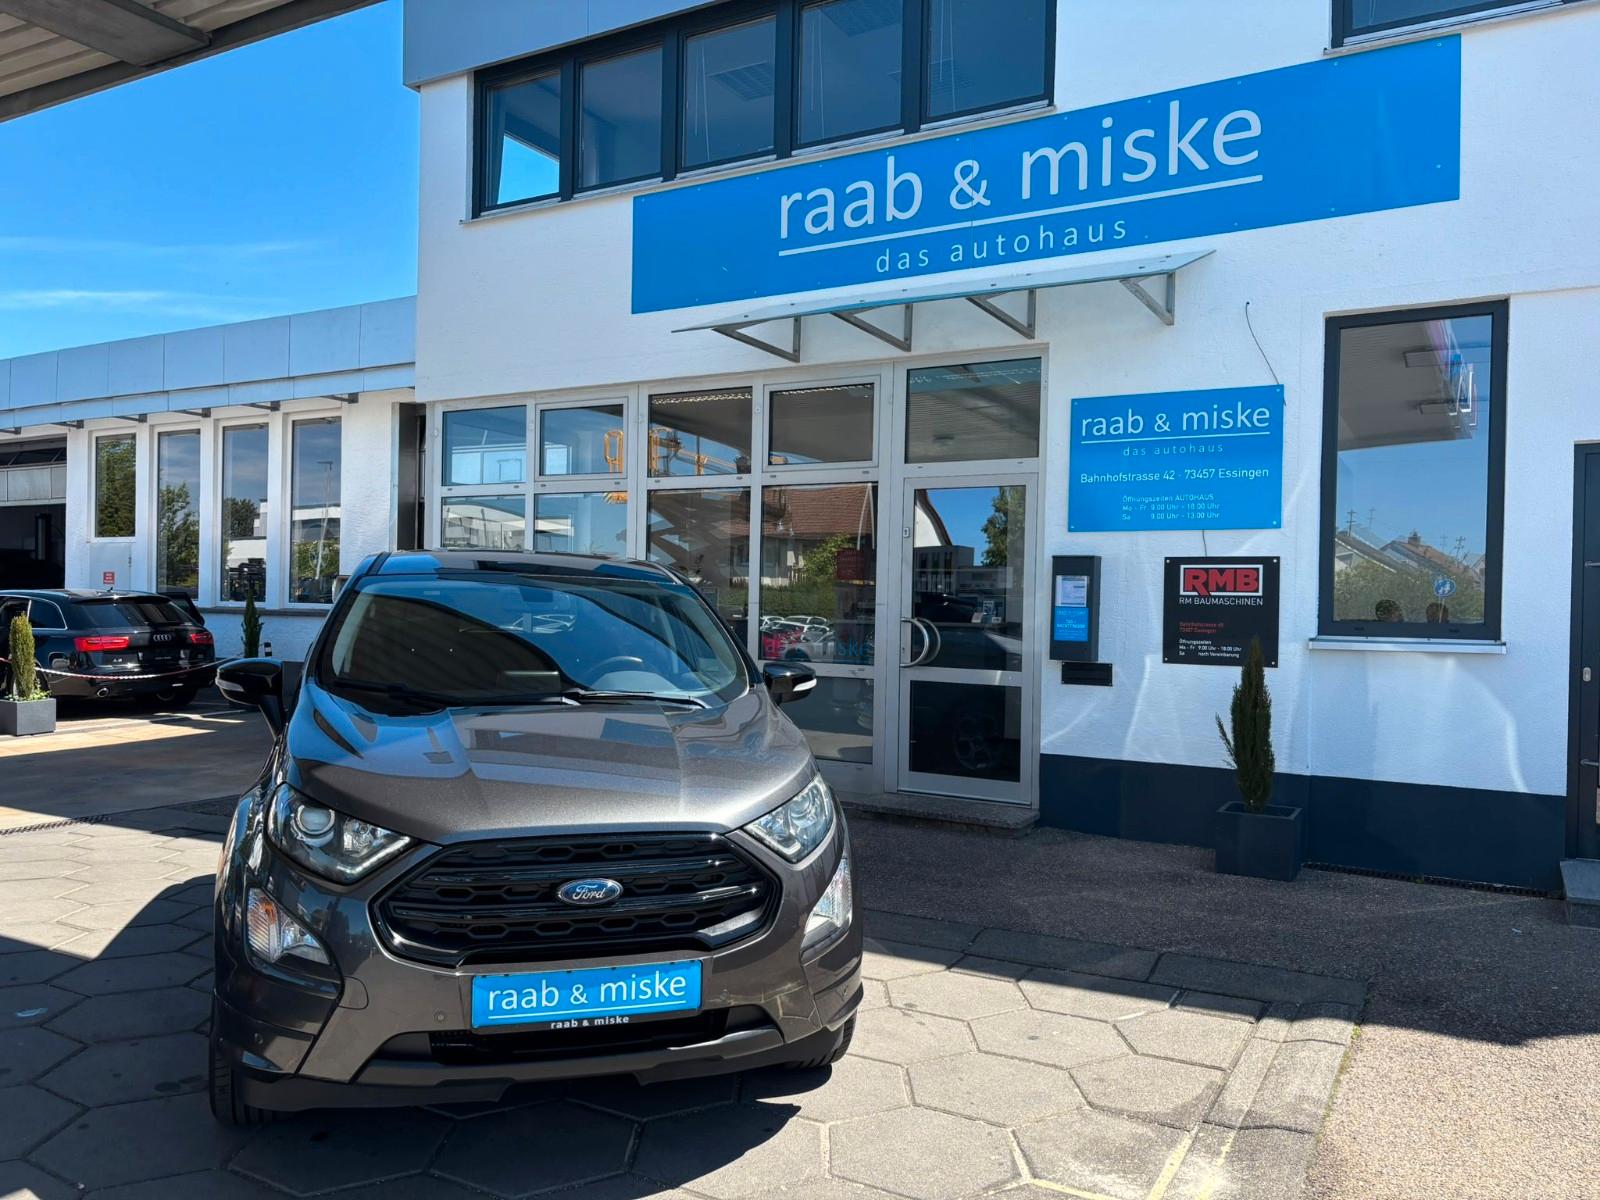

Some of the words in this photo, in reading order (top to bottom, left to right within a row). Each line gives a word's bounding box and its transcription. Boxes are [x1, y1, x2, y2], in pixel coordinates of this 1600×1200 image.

[779, 155, 924, 240] raab
[949, 159, 992, 211] &
[1020, 99, 1264, 200] miske
[876, 249, 930, 275] das
[949, 218, 1128, 264] autohaus
[1081, 408, 1144, 437] raab
[1154, 413, 1171, 433] &
[1182, 401, 1270, 432] miske
[1123, 446, 1147, 457] das
[1153, 442, 1224, 456] autohaus
[1080, 471, 1160, 483] Bahnhofstrasse
[1163, 469, 1176, 481] 42
[1184, 468, 1216, 480] 73457
[1218, 468, 1270, 481] Essingen
[1175, 493, 1214, 501] AUTOHAUS
[1184, 568, 1259, 597] RMB
[1179, 597, 1192, 605] RM
[1194, 597, 1264, 606] BAUMASCHINEN
[572, 884, 606, 901] Ford
[488, 979, 559, 1011] raab
[570, 983, 588, 1005] &
[600, 970, 687, 1003] miske
[550, 1019, 579, 1030] raab
[582, 1018, 590, 1027] &
[594, 1015, 630, 1026] miske
